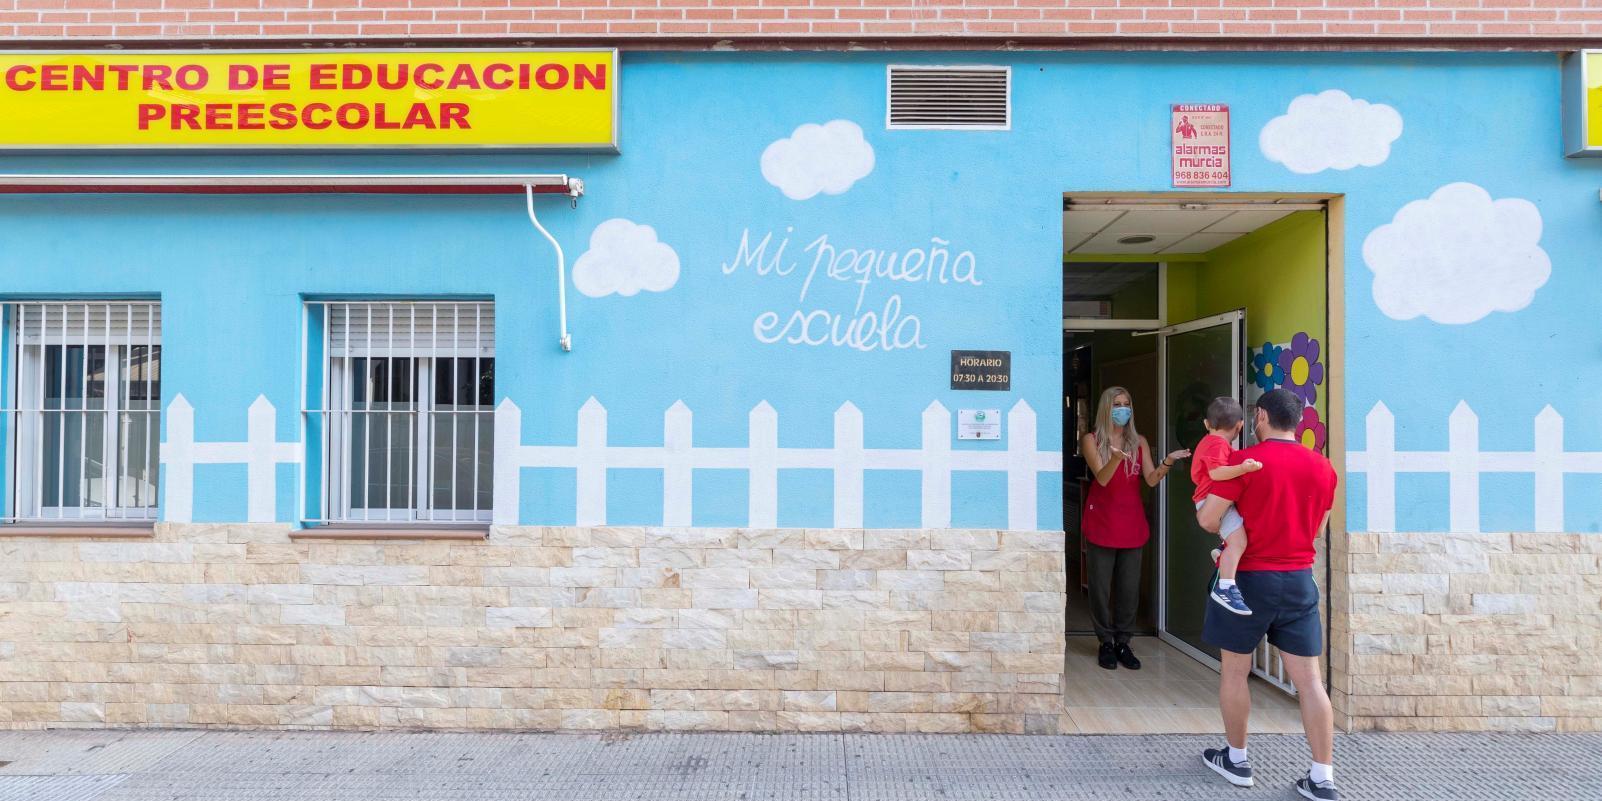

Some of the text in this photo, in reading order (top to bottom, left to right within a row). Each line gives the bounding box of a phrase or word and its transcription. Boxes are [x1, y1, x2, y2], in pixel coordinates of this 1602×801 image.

[6, 63, 607, 91] CENTRO DE EDUCACION
[138, 102, 472, 131] PREESCOLAR
[1175, 144, 1226, 155] alarmas
[1179, 156, 1222, 168] murcia
[1175, 171, 1229, 179] 968 836 404
[722, 226, 983, 315] Mi pequeña
[753, 294, 928, 351] escuela
[960, 358, 1002, 367] HORARIO
[977, 375, 984, 383] A
